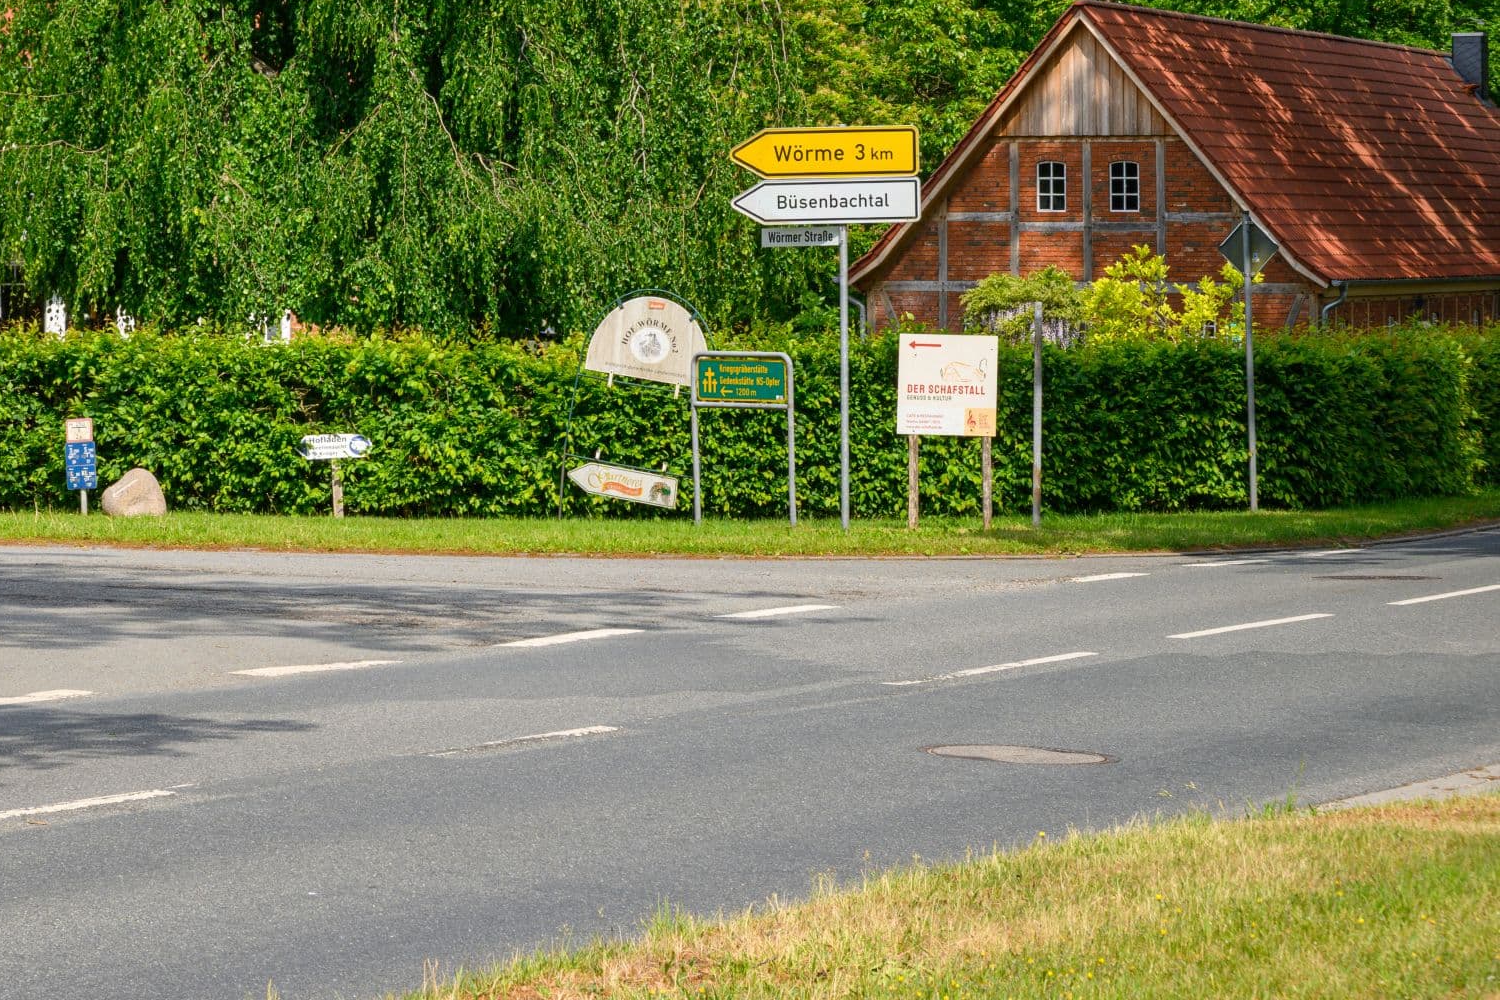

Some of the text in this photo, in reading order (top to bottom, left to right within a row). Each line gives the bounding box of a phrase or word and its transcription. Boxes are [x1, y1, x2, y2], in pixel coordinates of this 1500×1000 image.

[773, 143, 893, 162] Wörme 3 km
[777, 193, 889, 209] Büsenbachtal
[768, 230, 833, 243] Wörmer Straße
[637, 317, 672, 334] WÖRME
[907, 384, 986, 396] DER SCHAFSTALL
